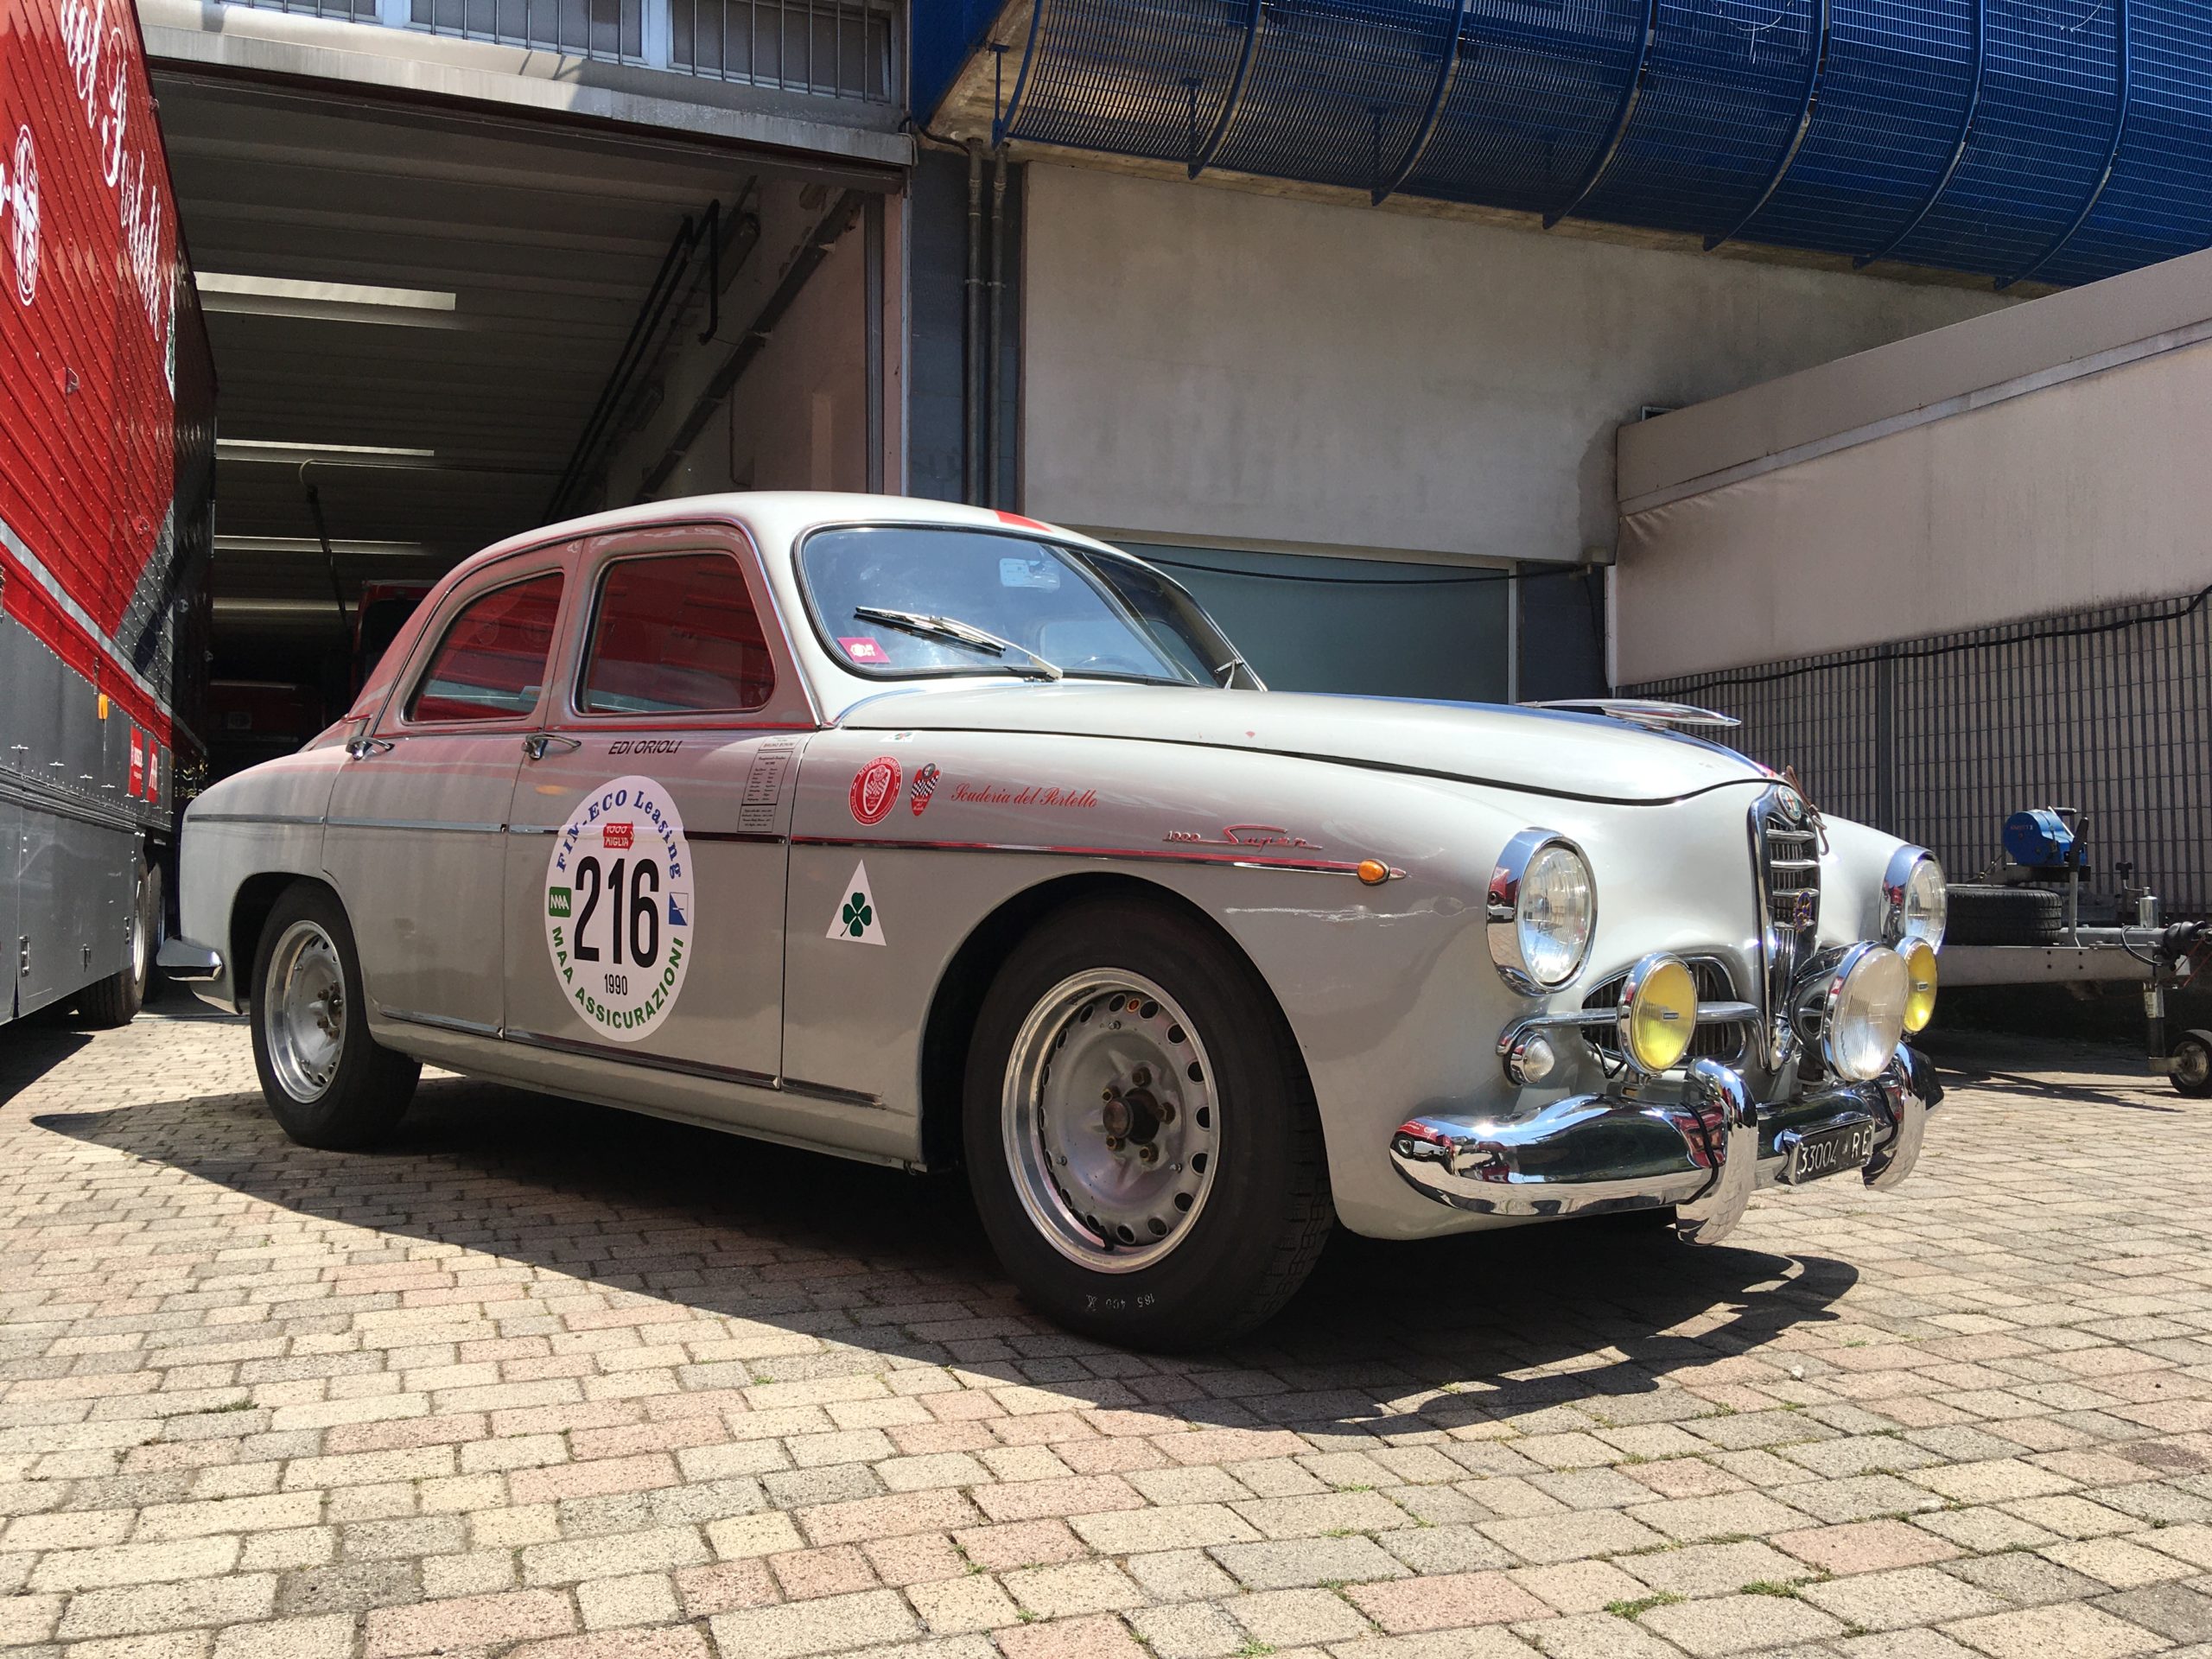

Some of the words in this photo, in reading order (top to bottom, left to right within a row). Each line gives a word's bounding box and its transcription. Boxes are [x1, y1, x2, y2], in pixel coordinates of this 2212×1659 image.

[608, 741, 635, 754] EDI
[634, 740, 683, 754] ORIOLI
[950, 782, 1010, 804] Scuderia
[1014, 786, 1042, 805] del
[1039, 786, 1098, 808] Portello
[556, 789, 627, 872] FIN-ECO
[633, 791, 682, 880] Leasing
[605, 836, 629, 847] MIGLIA
[574, 856, 659, 969] 216
[552, 926, 574, 984] MAA
[575, 937, 684, 1029] ASSICURAZIONI
[604, 974, 628, 995] 1990
